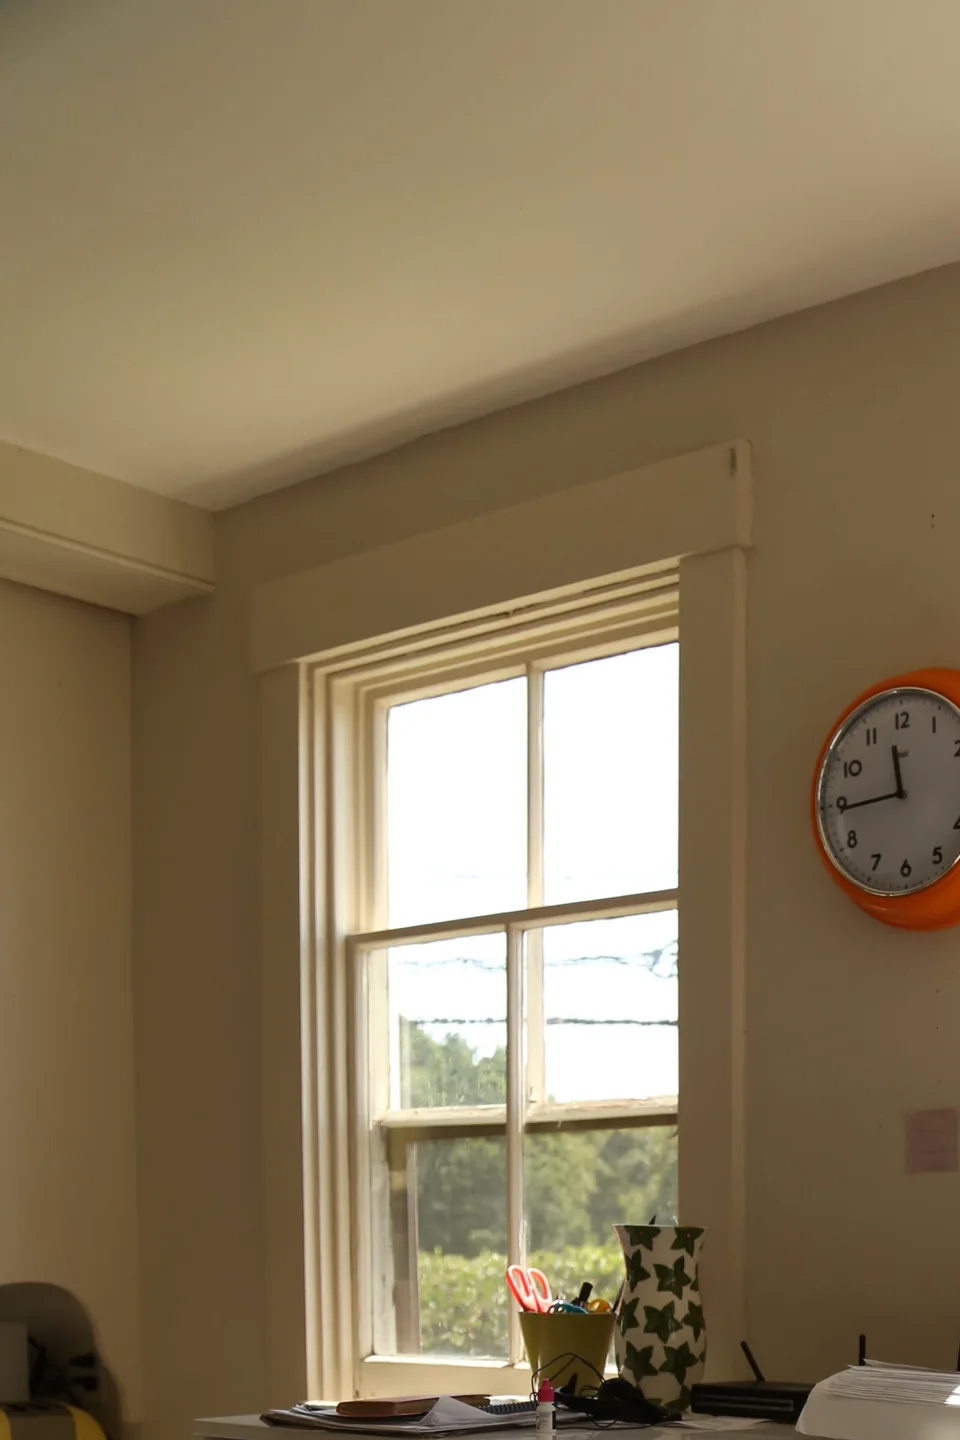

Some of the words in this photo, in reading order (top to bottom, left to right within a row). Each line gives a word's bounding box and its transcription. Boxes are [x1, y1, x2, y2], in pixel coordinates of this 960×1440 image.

[894, 711, 910, 731] 12
[931, 715, 937, 734] 1
[865, 727, 877, 746] 11
[843, 759, 863, 778] 10
[836, 796, 848, 814] 9
[847, 829, 858, 849] 8
[870, 853, 882, 871] 7
[932, 846, 943, 865] 5
[900, 859, 912, 878] 6
